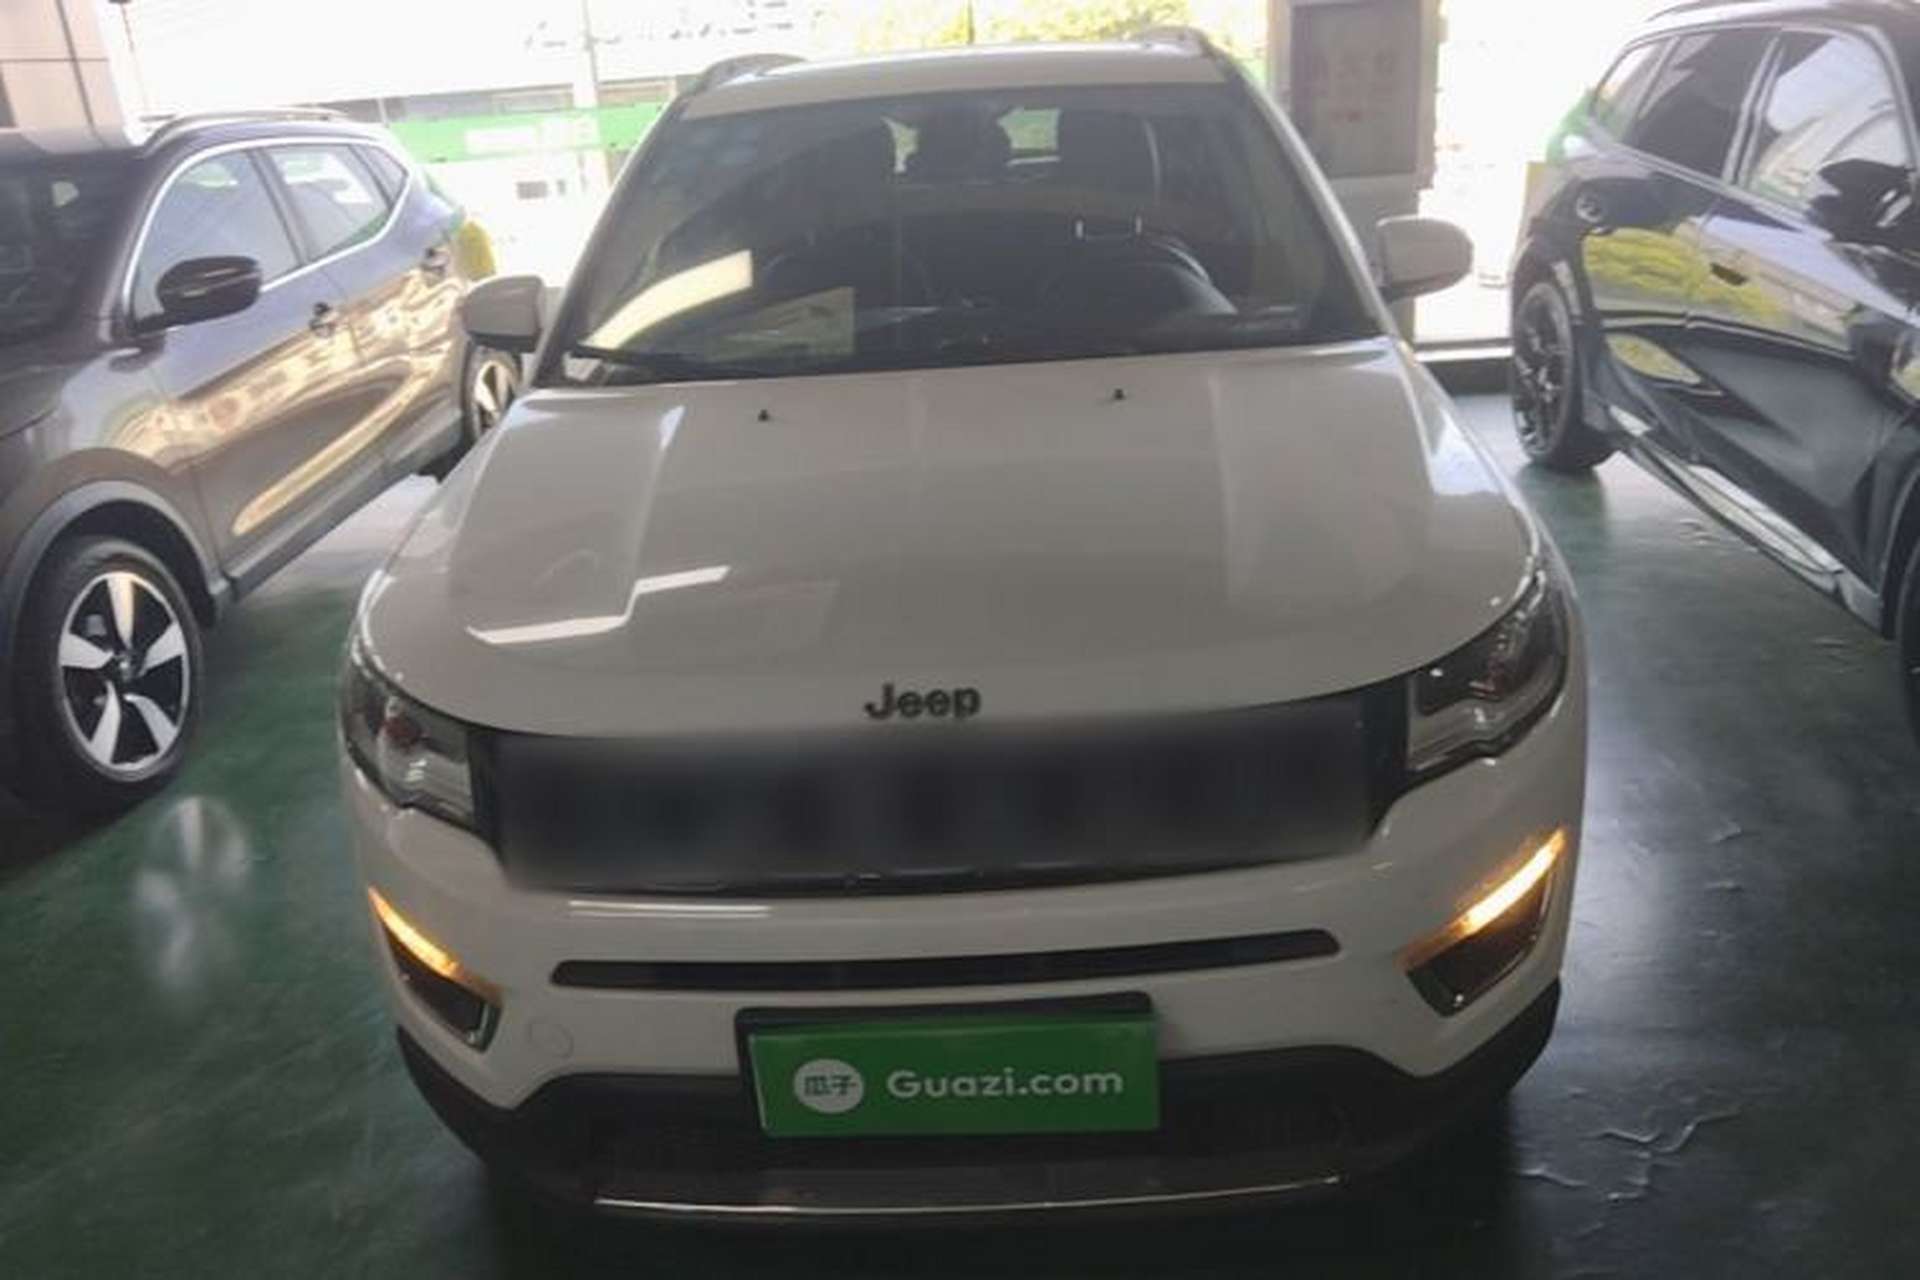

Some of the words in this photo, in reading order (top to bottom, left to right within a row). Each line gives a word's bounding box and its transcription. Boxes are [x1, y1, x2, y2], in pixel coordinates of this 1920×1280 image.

[864, 683, 982, 720] Jeep
[803, 1074, 858, 1097] 瓜子
[887, 1067, 1124, 1099] Guazi.com
